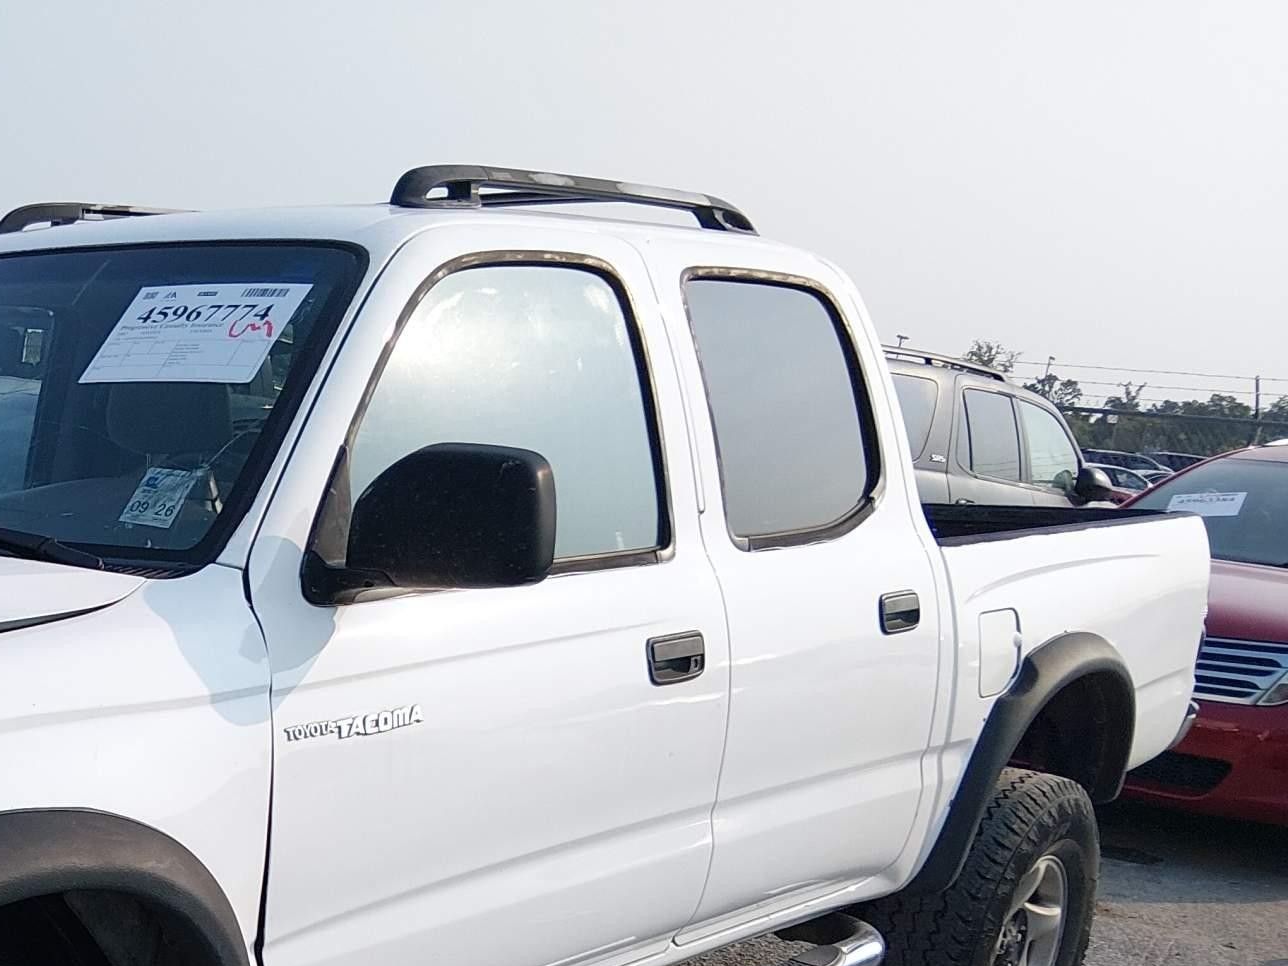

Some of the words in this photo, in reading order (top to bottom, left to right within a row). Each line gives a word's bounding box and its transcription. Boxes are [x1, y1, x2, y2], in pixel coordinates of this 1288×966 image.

[137, 303, 275, 324] 45967774
[129, 500, 150, 514] 09
[154, 503, 176, 517] 26
[284, 720, 337, 742] TOYOTA
[336, 703, 425, 739] TACOMA
